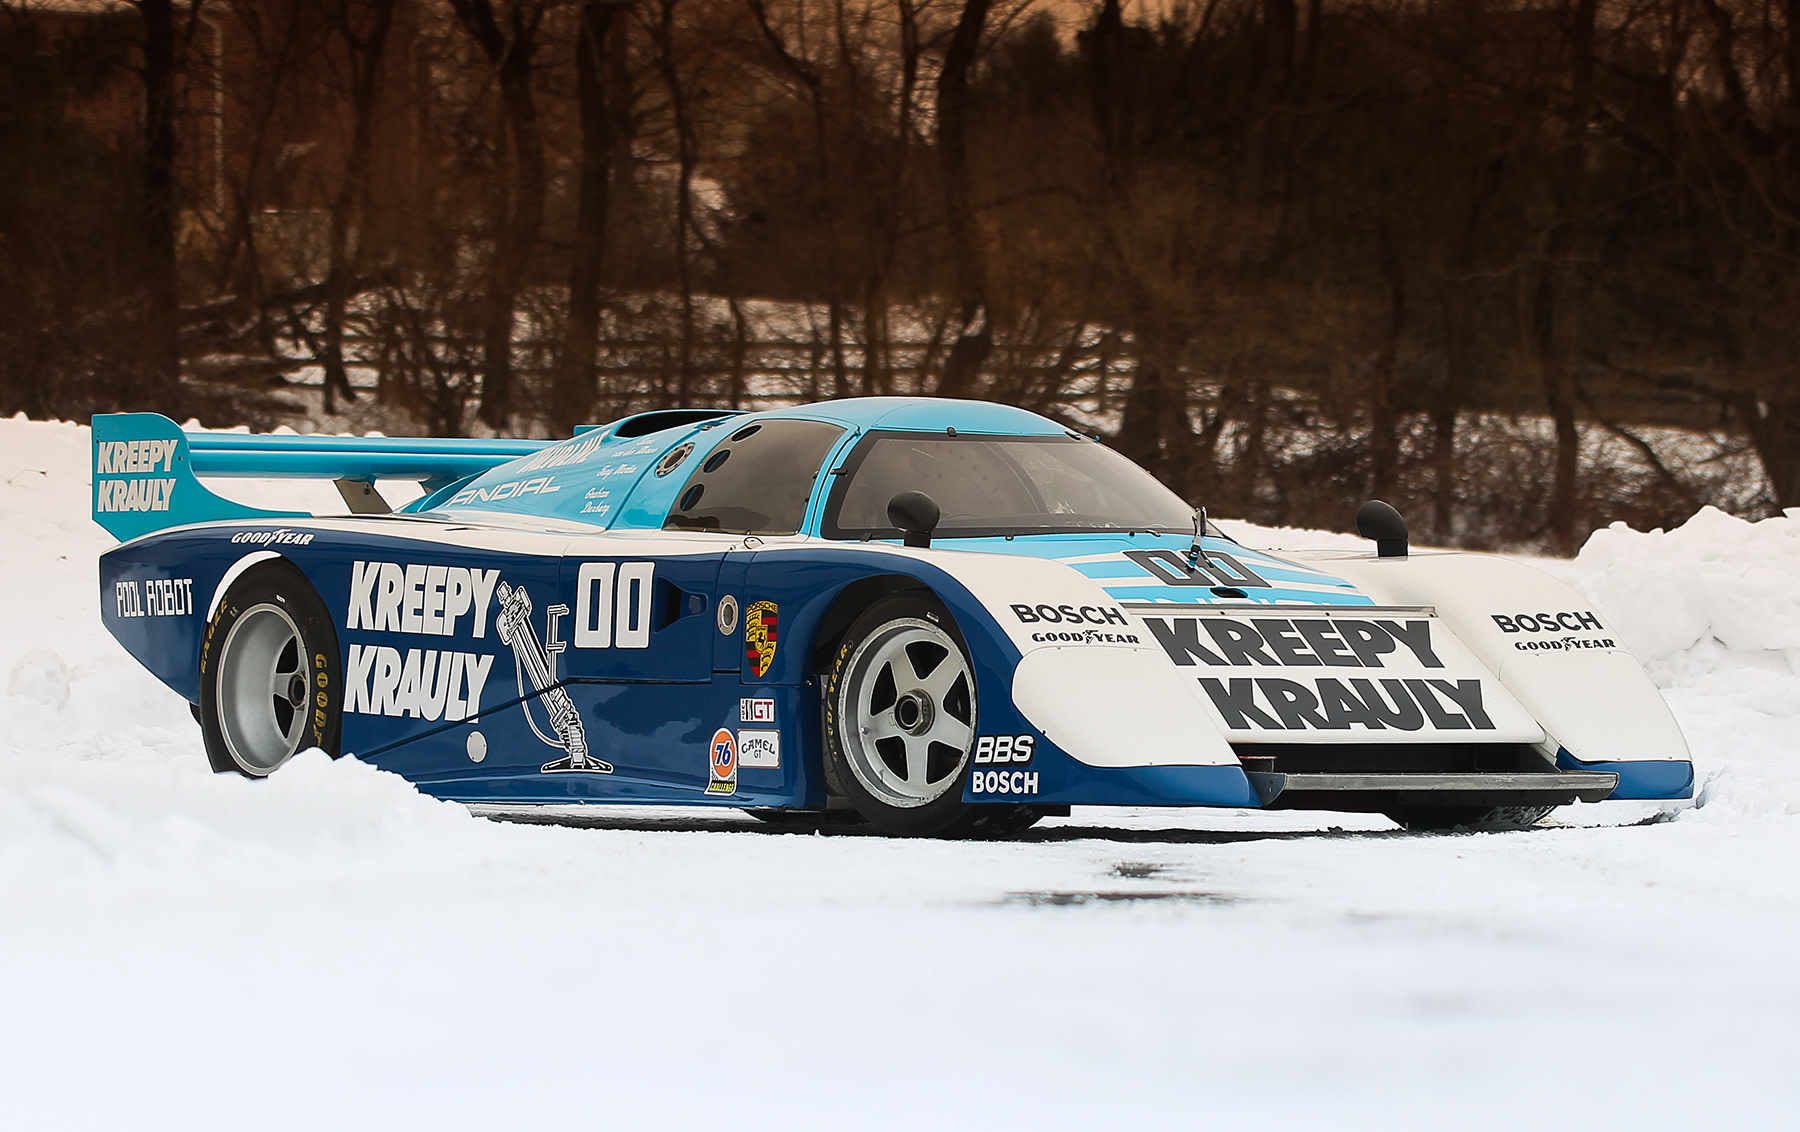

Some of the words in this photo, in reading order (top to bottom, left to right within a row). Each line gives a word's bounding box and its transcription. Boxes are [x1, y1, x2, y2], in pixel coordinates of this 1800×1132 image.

[97, 439, 178, 474] KREEPY
[97, 478, 176, 513] KRAULY
[447, 476, 562, 507] ANDIAL
[231, 529, 315, 547] GOODYEAR
[116, 580, 145, 618] POOL
[146, 578, 193, 616] ROBOT
[346, 560, 501, 638] KREEPY
[573, 561, 655, 649] 00
[1009, 604, 1129, 626] BOSCH
[1490, 611, 1604, 634] BOSCH
[1031, 629, 1140, 645] GOODYEAR
[1142, 617, 1445, 668] KREEPY
[1515, 636, 1616, 652] GOODYEAR
[343, 644, 495, 724] KRAULY
[754, 701, 773, 719] GT
[1197, 677, 1497, 731] KRAULY
[714, 741, 732, 766] 76
[741, 738, 776, 755] CAMEL
[753, 749, 763, 759] GT
[974, 735, 1035, 765] BBS
[972, 771, 1039, 795] BOSCH
